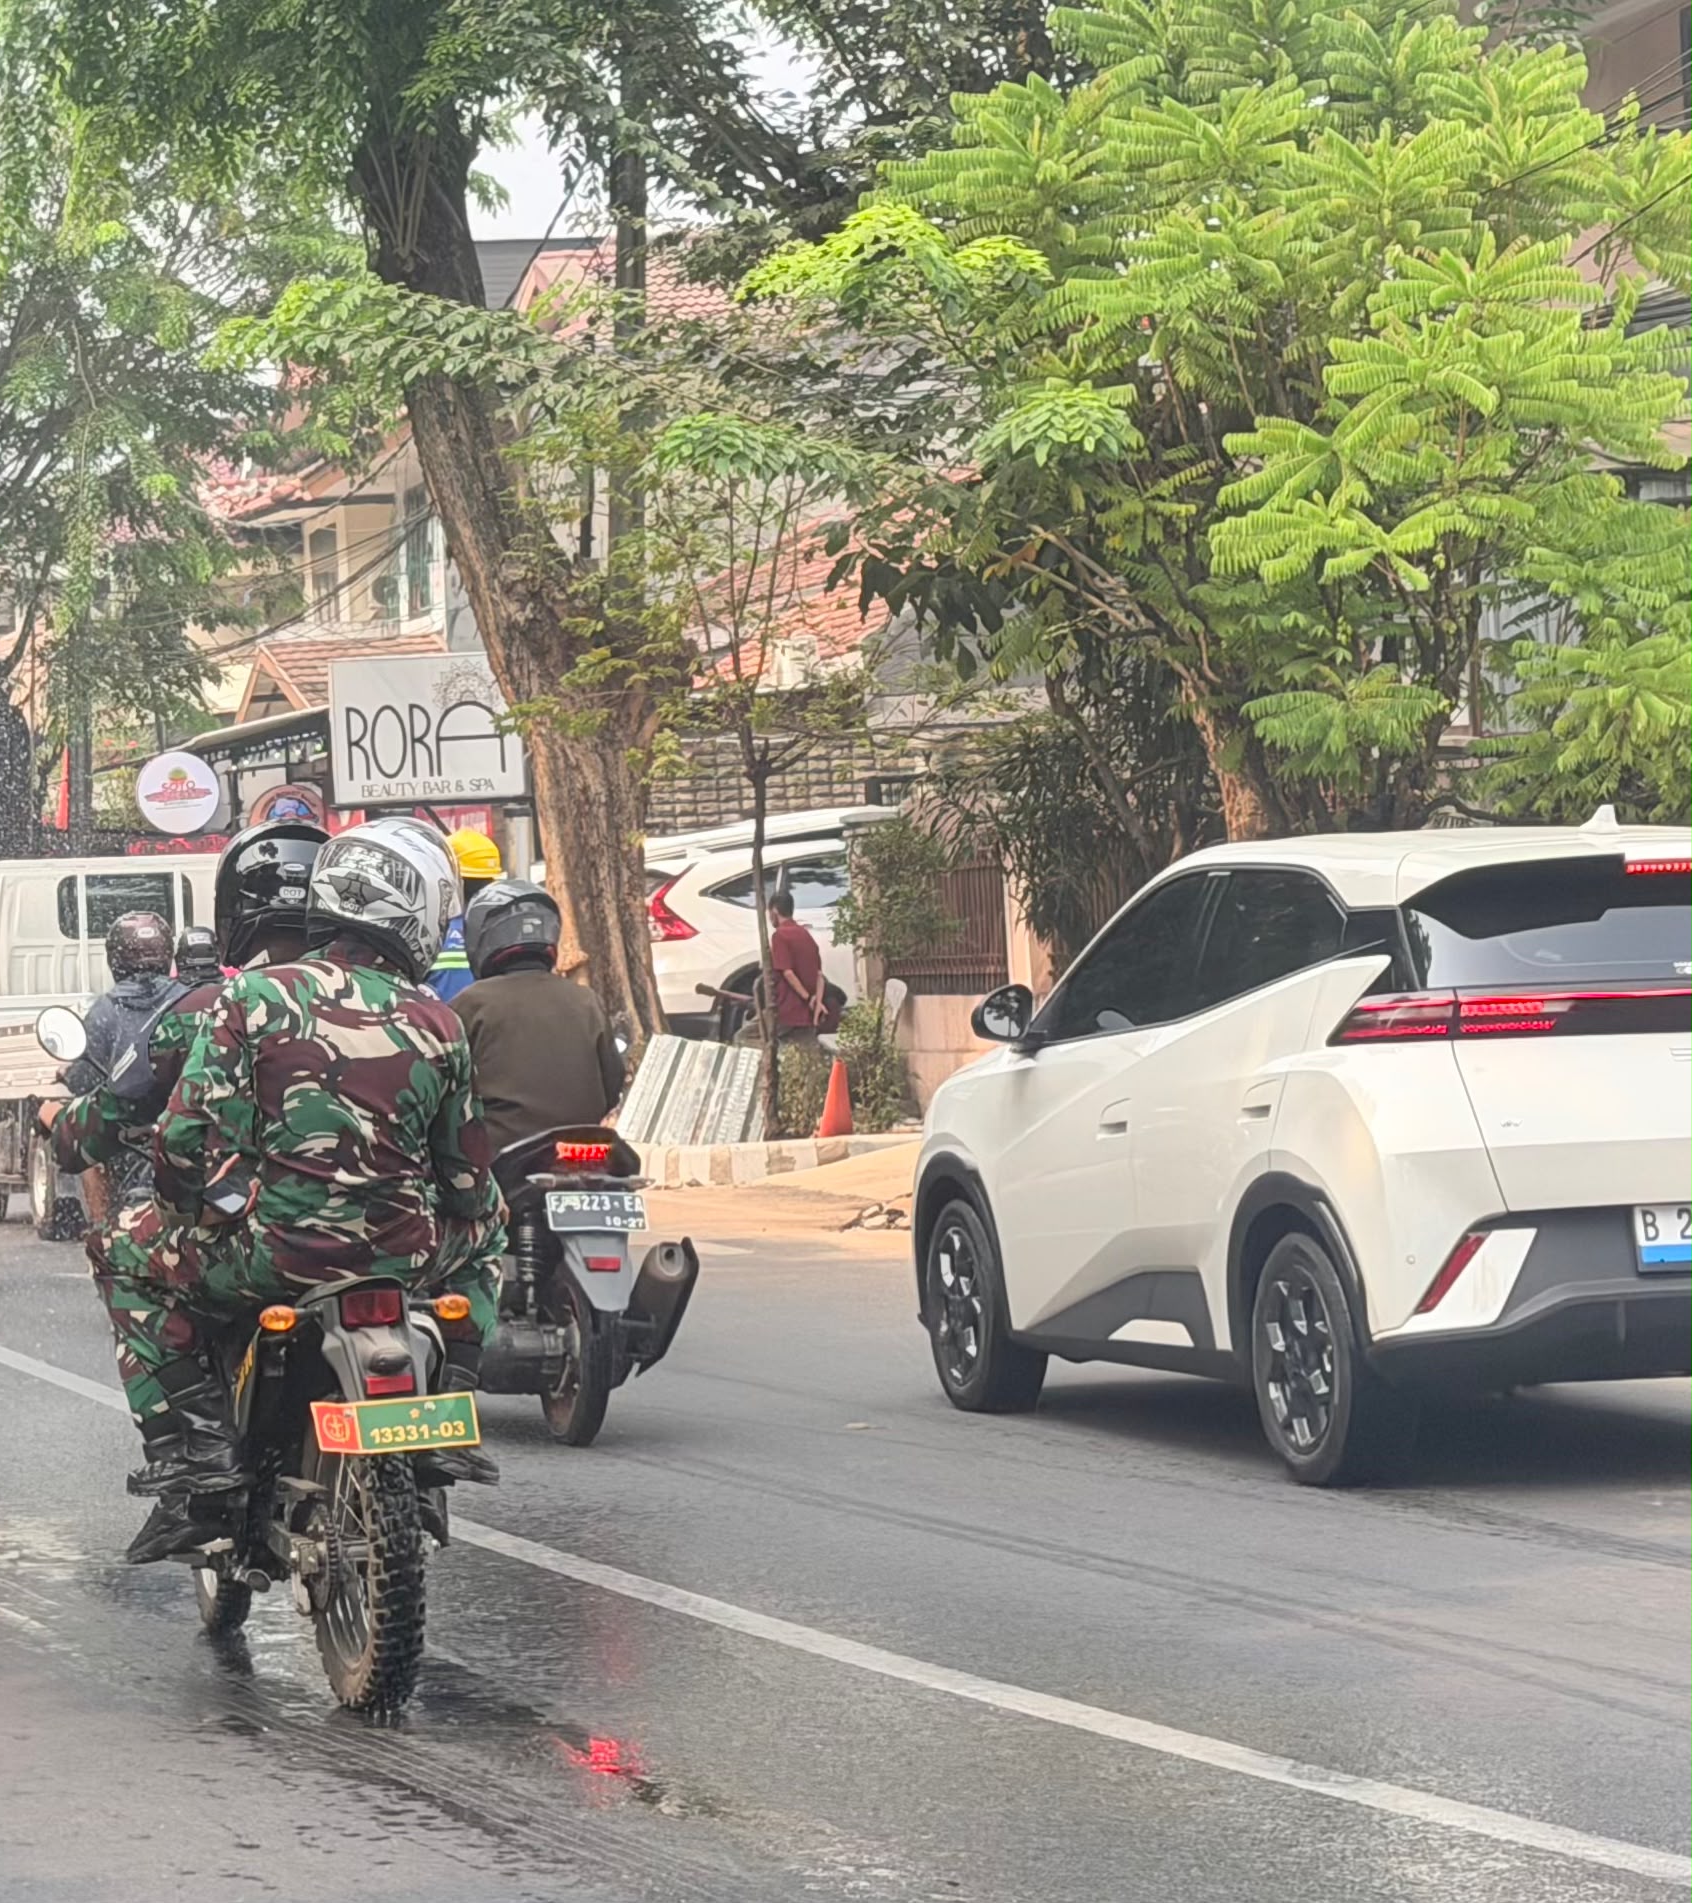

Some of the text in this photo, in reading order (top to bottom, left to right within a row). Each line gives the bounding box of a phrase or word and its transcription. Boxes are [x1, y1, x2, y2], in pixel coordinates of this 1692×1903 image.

[345, 701, 507, 782] RORA
[361, 777, 496, 798] BEAUTY BAR & SPA
[283, 888, 302, 897] DOT
[623, 1196, 645, 1212] EA
[1641, 1209, 1660, 1242] B
[369, 1420, 466, 1444] 13331-03
